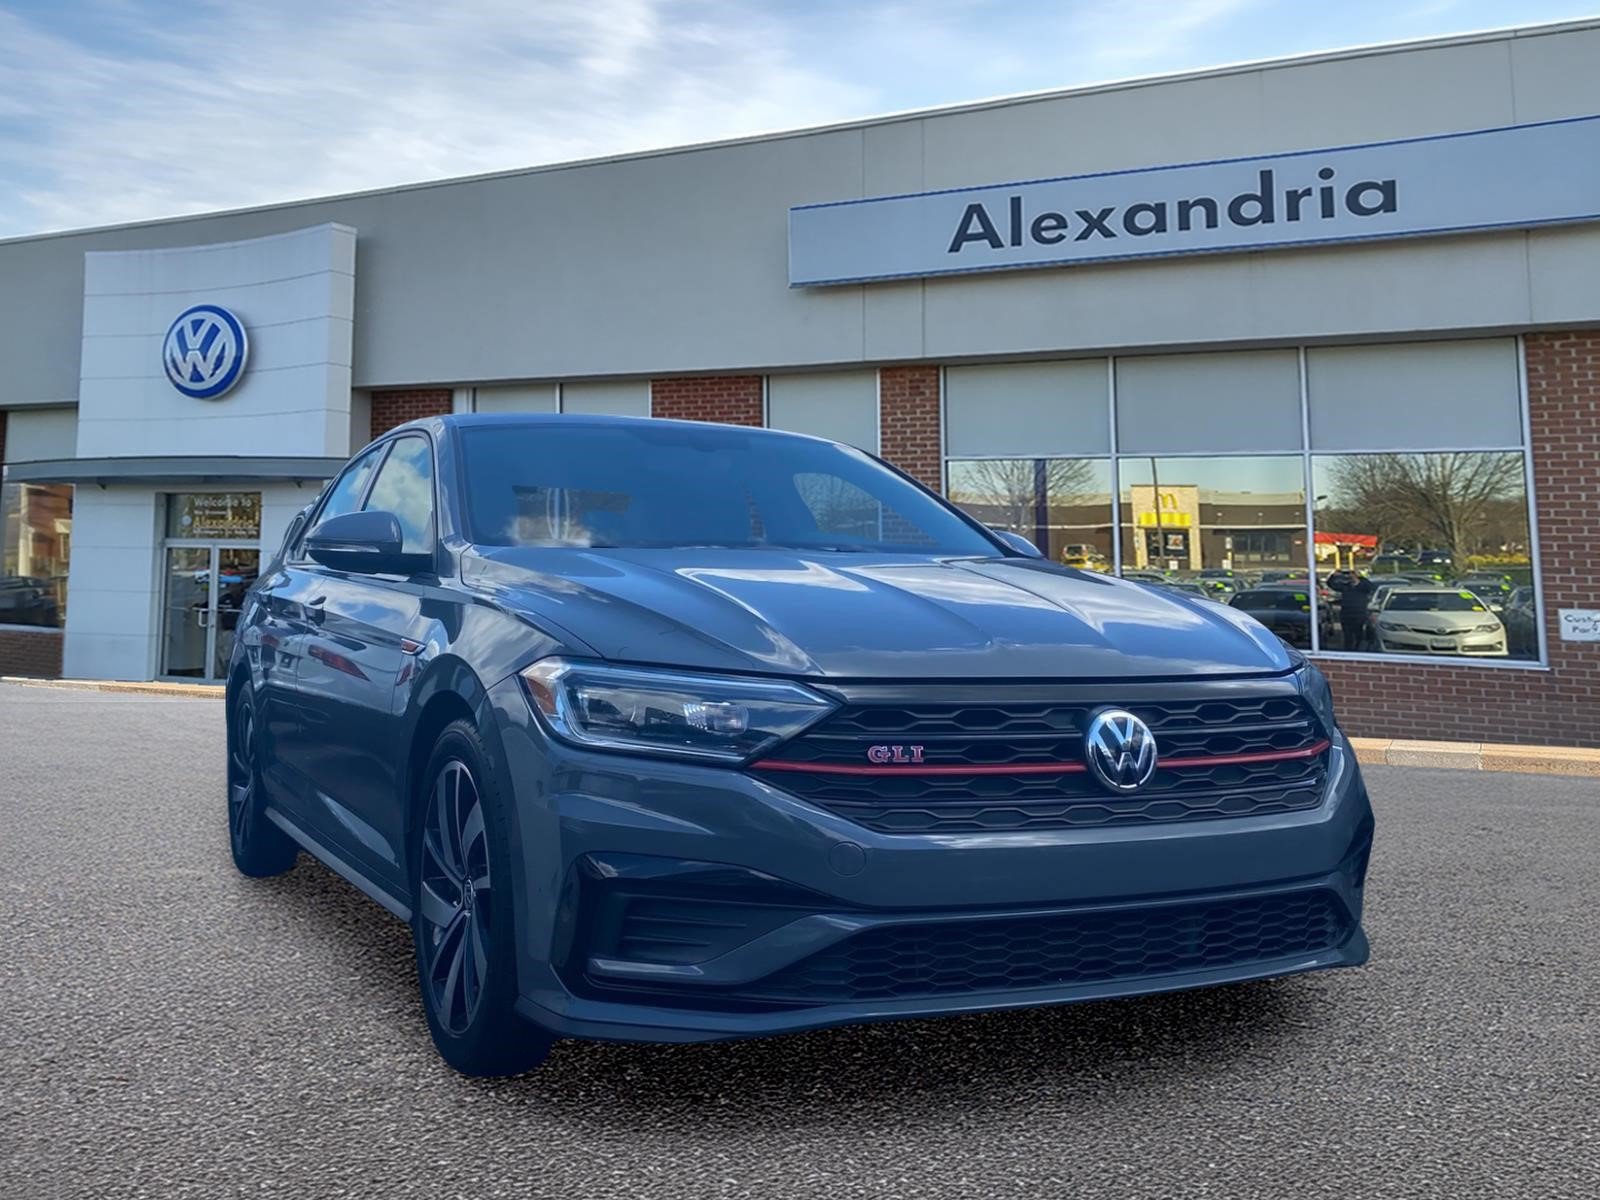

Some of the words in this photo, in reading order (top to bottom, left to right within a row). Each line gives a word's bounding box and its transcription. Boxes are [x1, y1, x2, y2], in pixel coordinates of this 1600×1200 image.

[947, 167, 1398, 253] Alexandria
[167, 308, 241, 393] VW
[867, 745, 925, 763] GLI
[1088, 712, 1156, 790] VW
